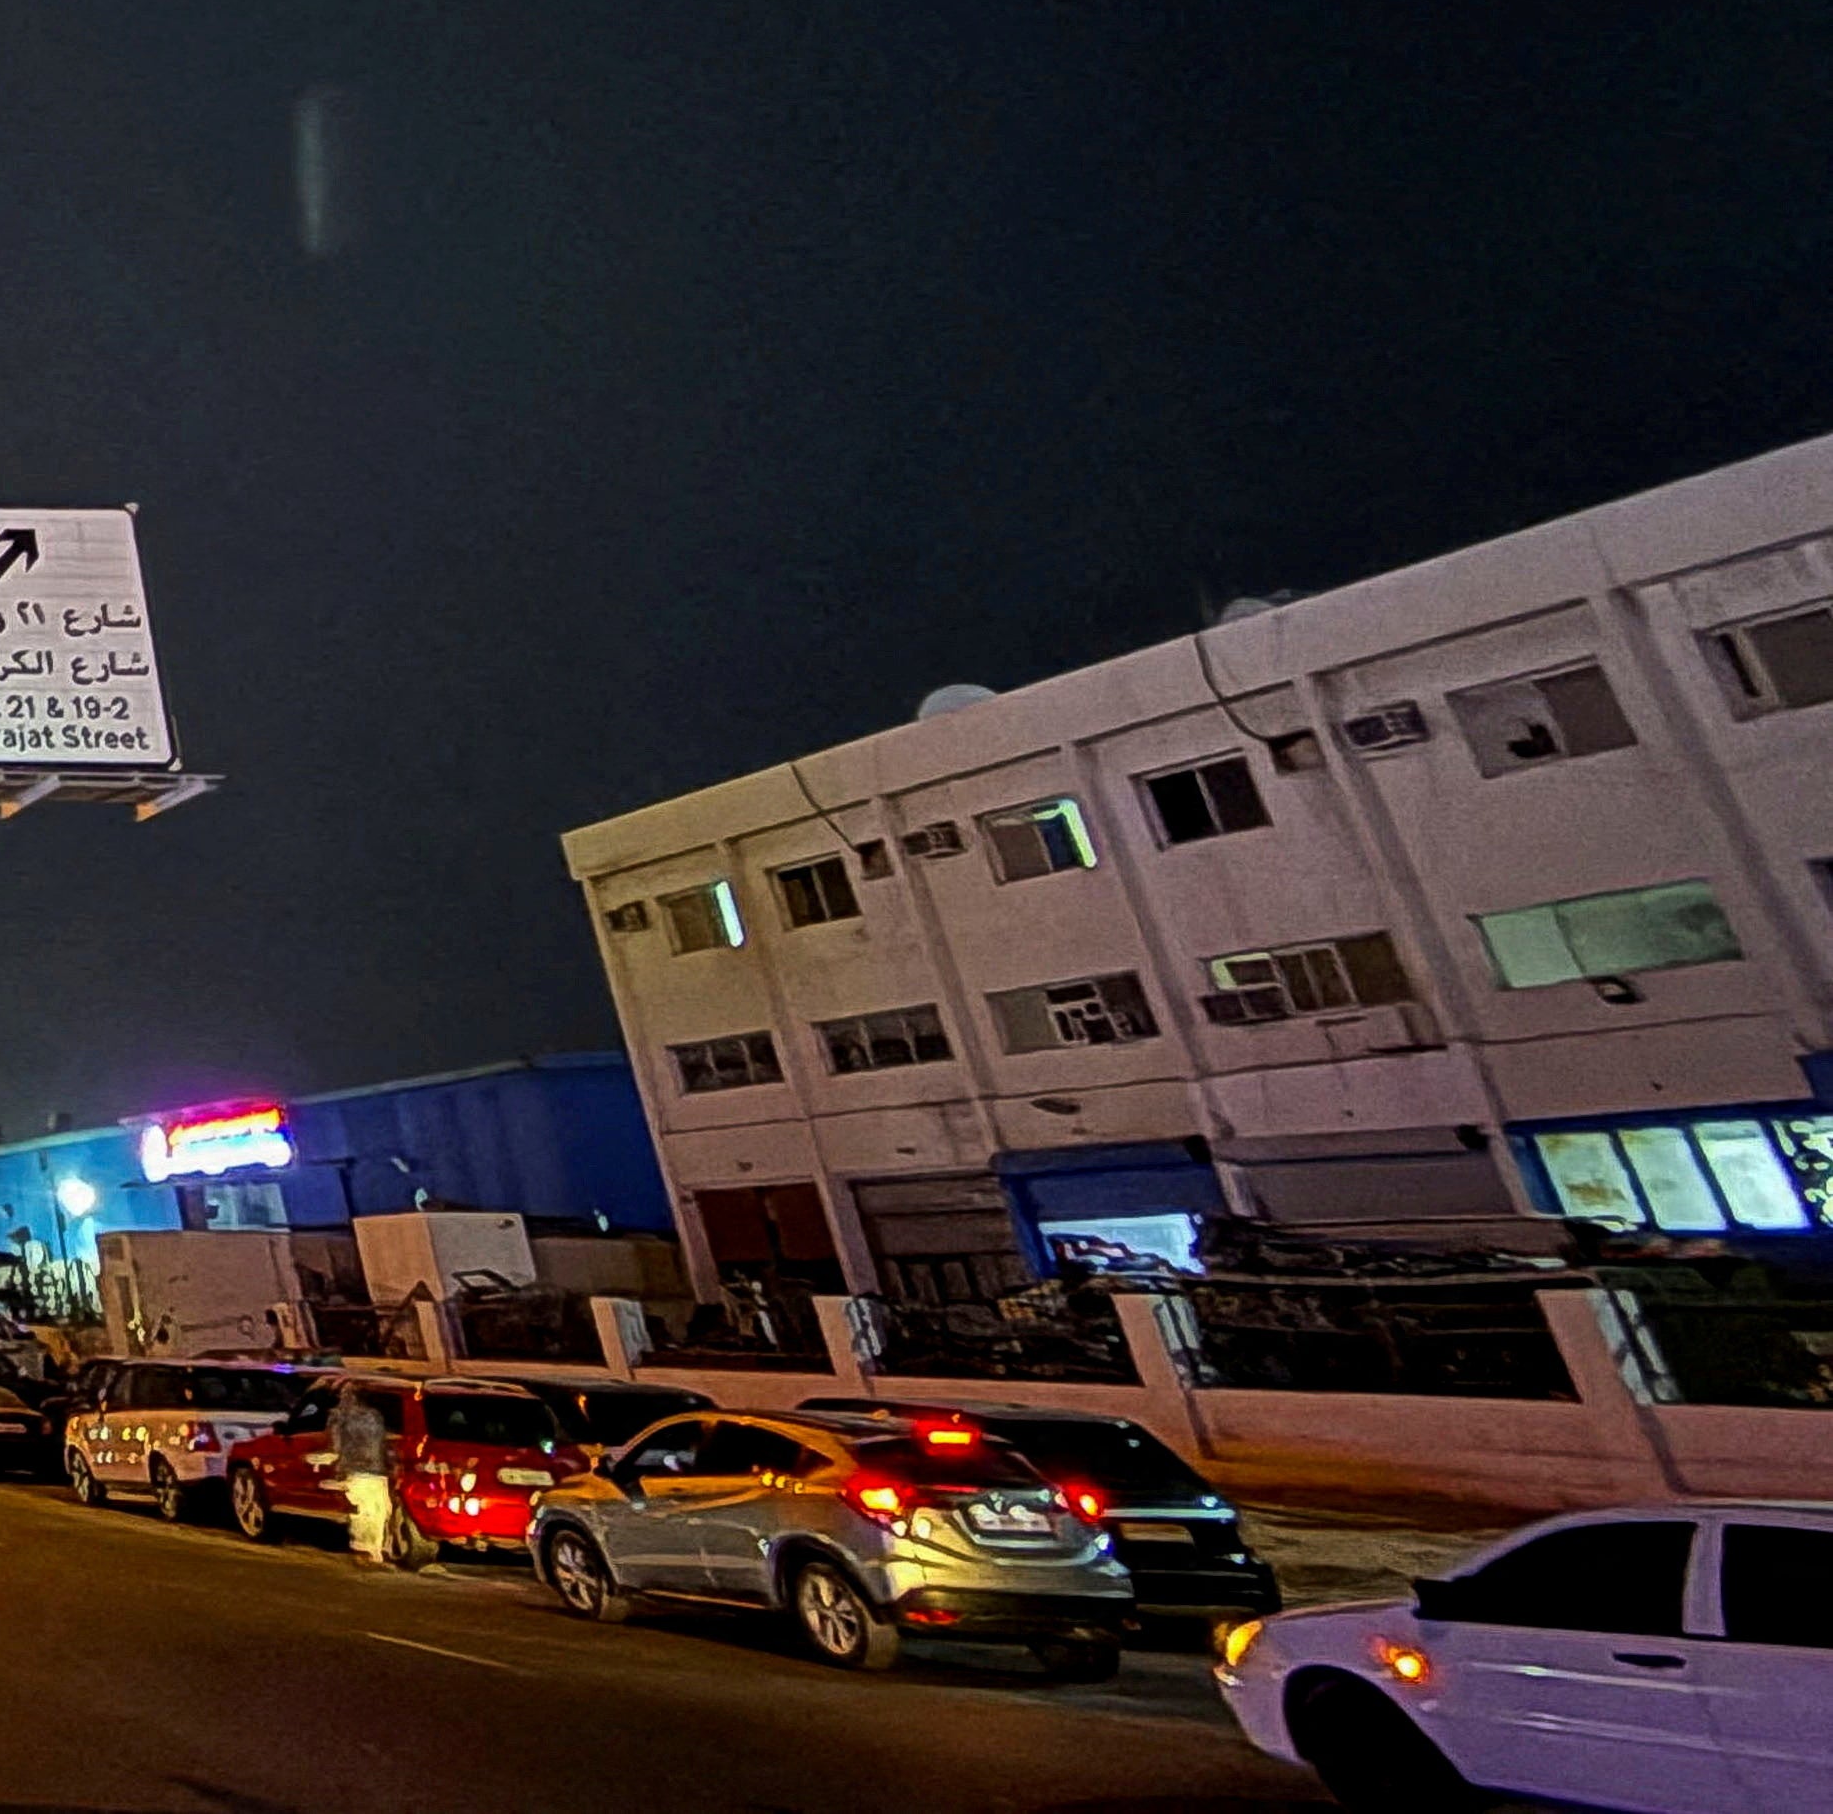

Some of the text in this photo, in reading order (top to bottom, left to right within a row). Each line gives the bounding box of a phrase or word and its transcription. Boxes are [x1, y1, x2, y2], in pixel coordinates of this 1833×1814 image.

[17, 601, 45, 625] ٢١
[63, 603, 142, 636] شارع
[71, 651, 150, 685] شارع
[7, 694, 35, 719] 21
[47, 695, 64, 719] &
[72, 695, 131, 720] 19-2
[63, 724, 151, 750] Street
